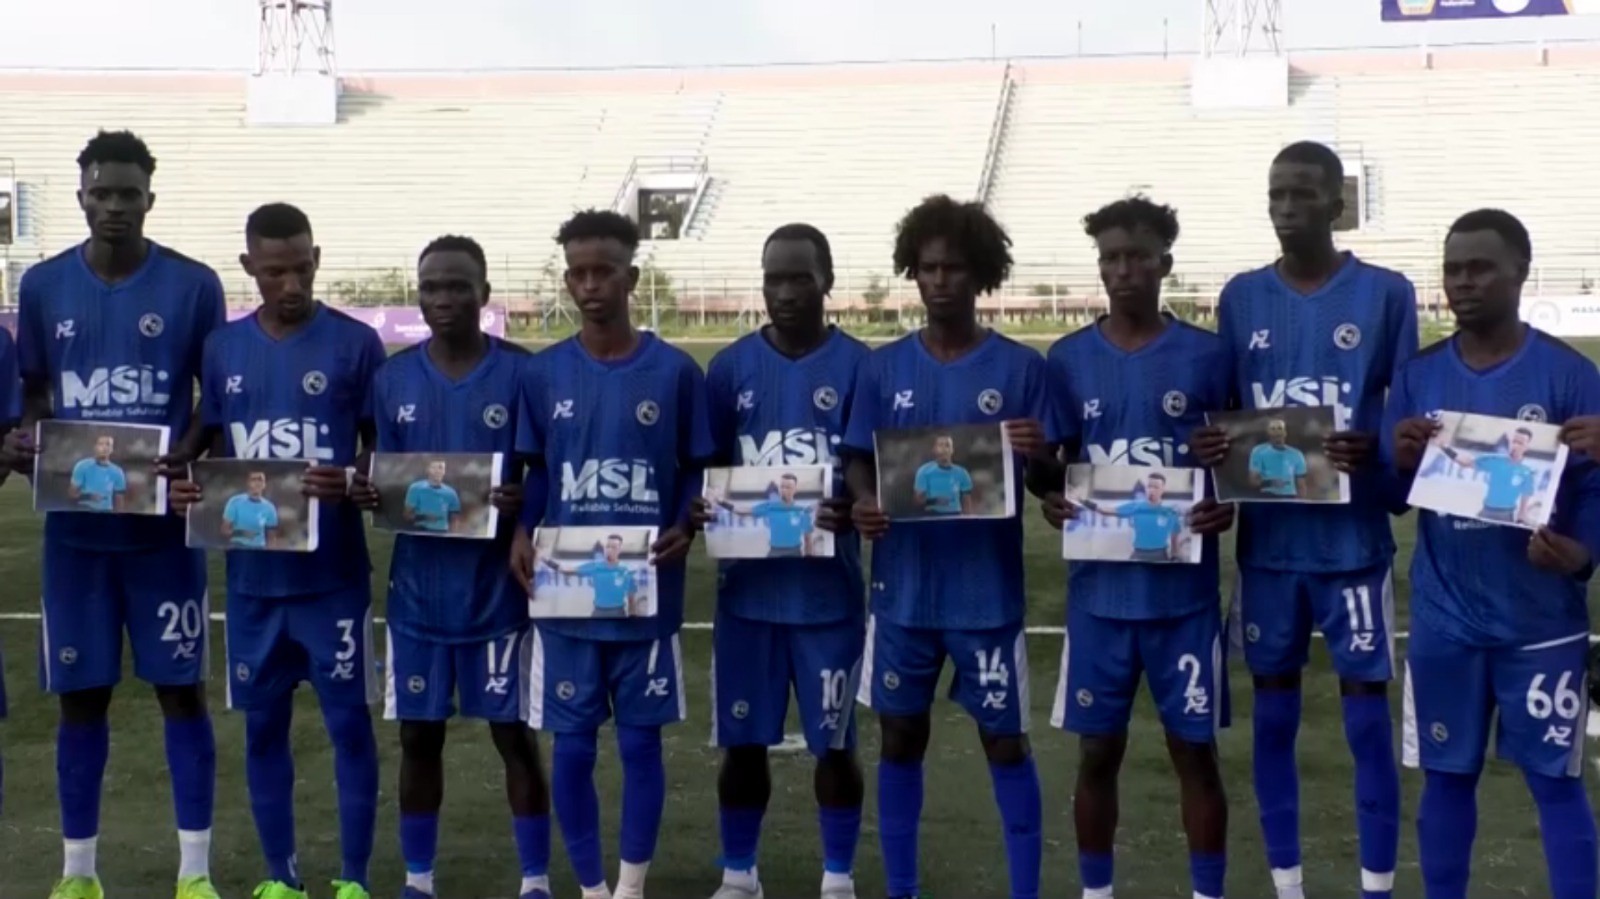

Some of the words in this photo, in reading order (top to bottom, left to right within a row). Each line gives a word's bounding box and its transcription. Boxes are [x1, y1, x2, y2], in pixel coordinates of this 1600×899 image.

[156, 599, 201, 642] 20
[1342, 585, 1374, 631] 11
[335, 619, 356, 661] 3
[487, 632, 518, 674] 17
[975, 646, 1009, 687] 14
[1177, 652, 1203, 696] 2
[820, 669, 847, 711] 10
[1526, 671, 1580, 719] 66
